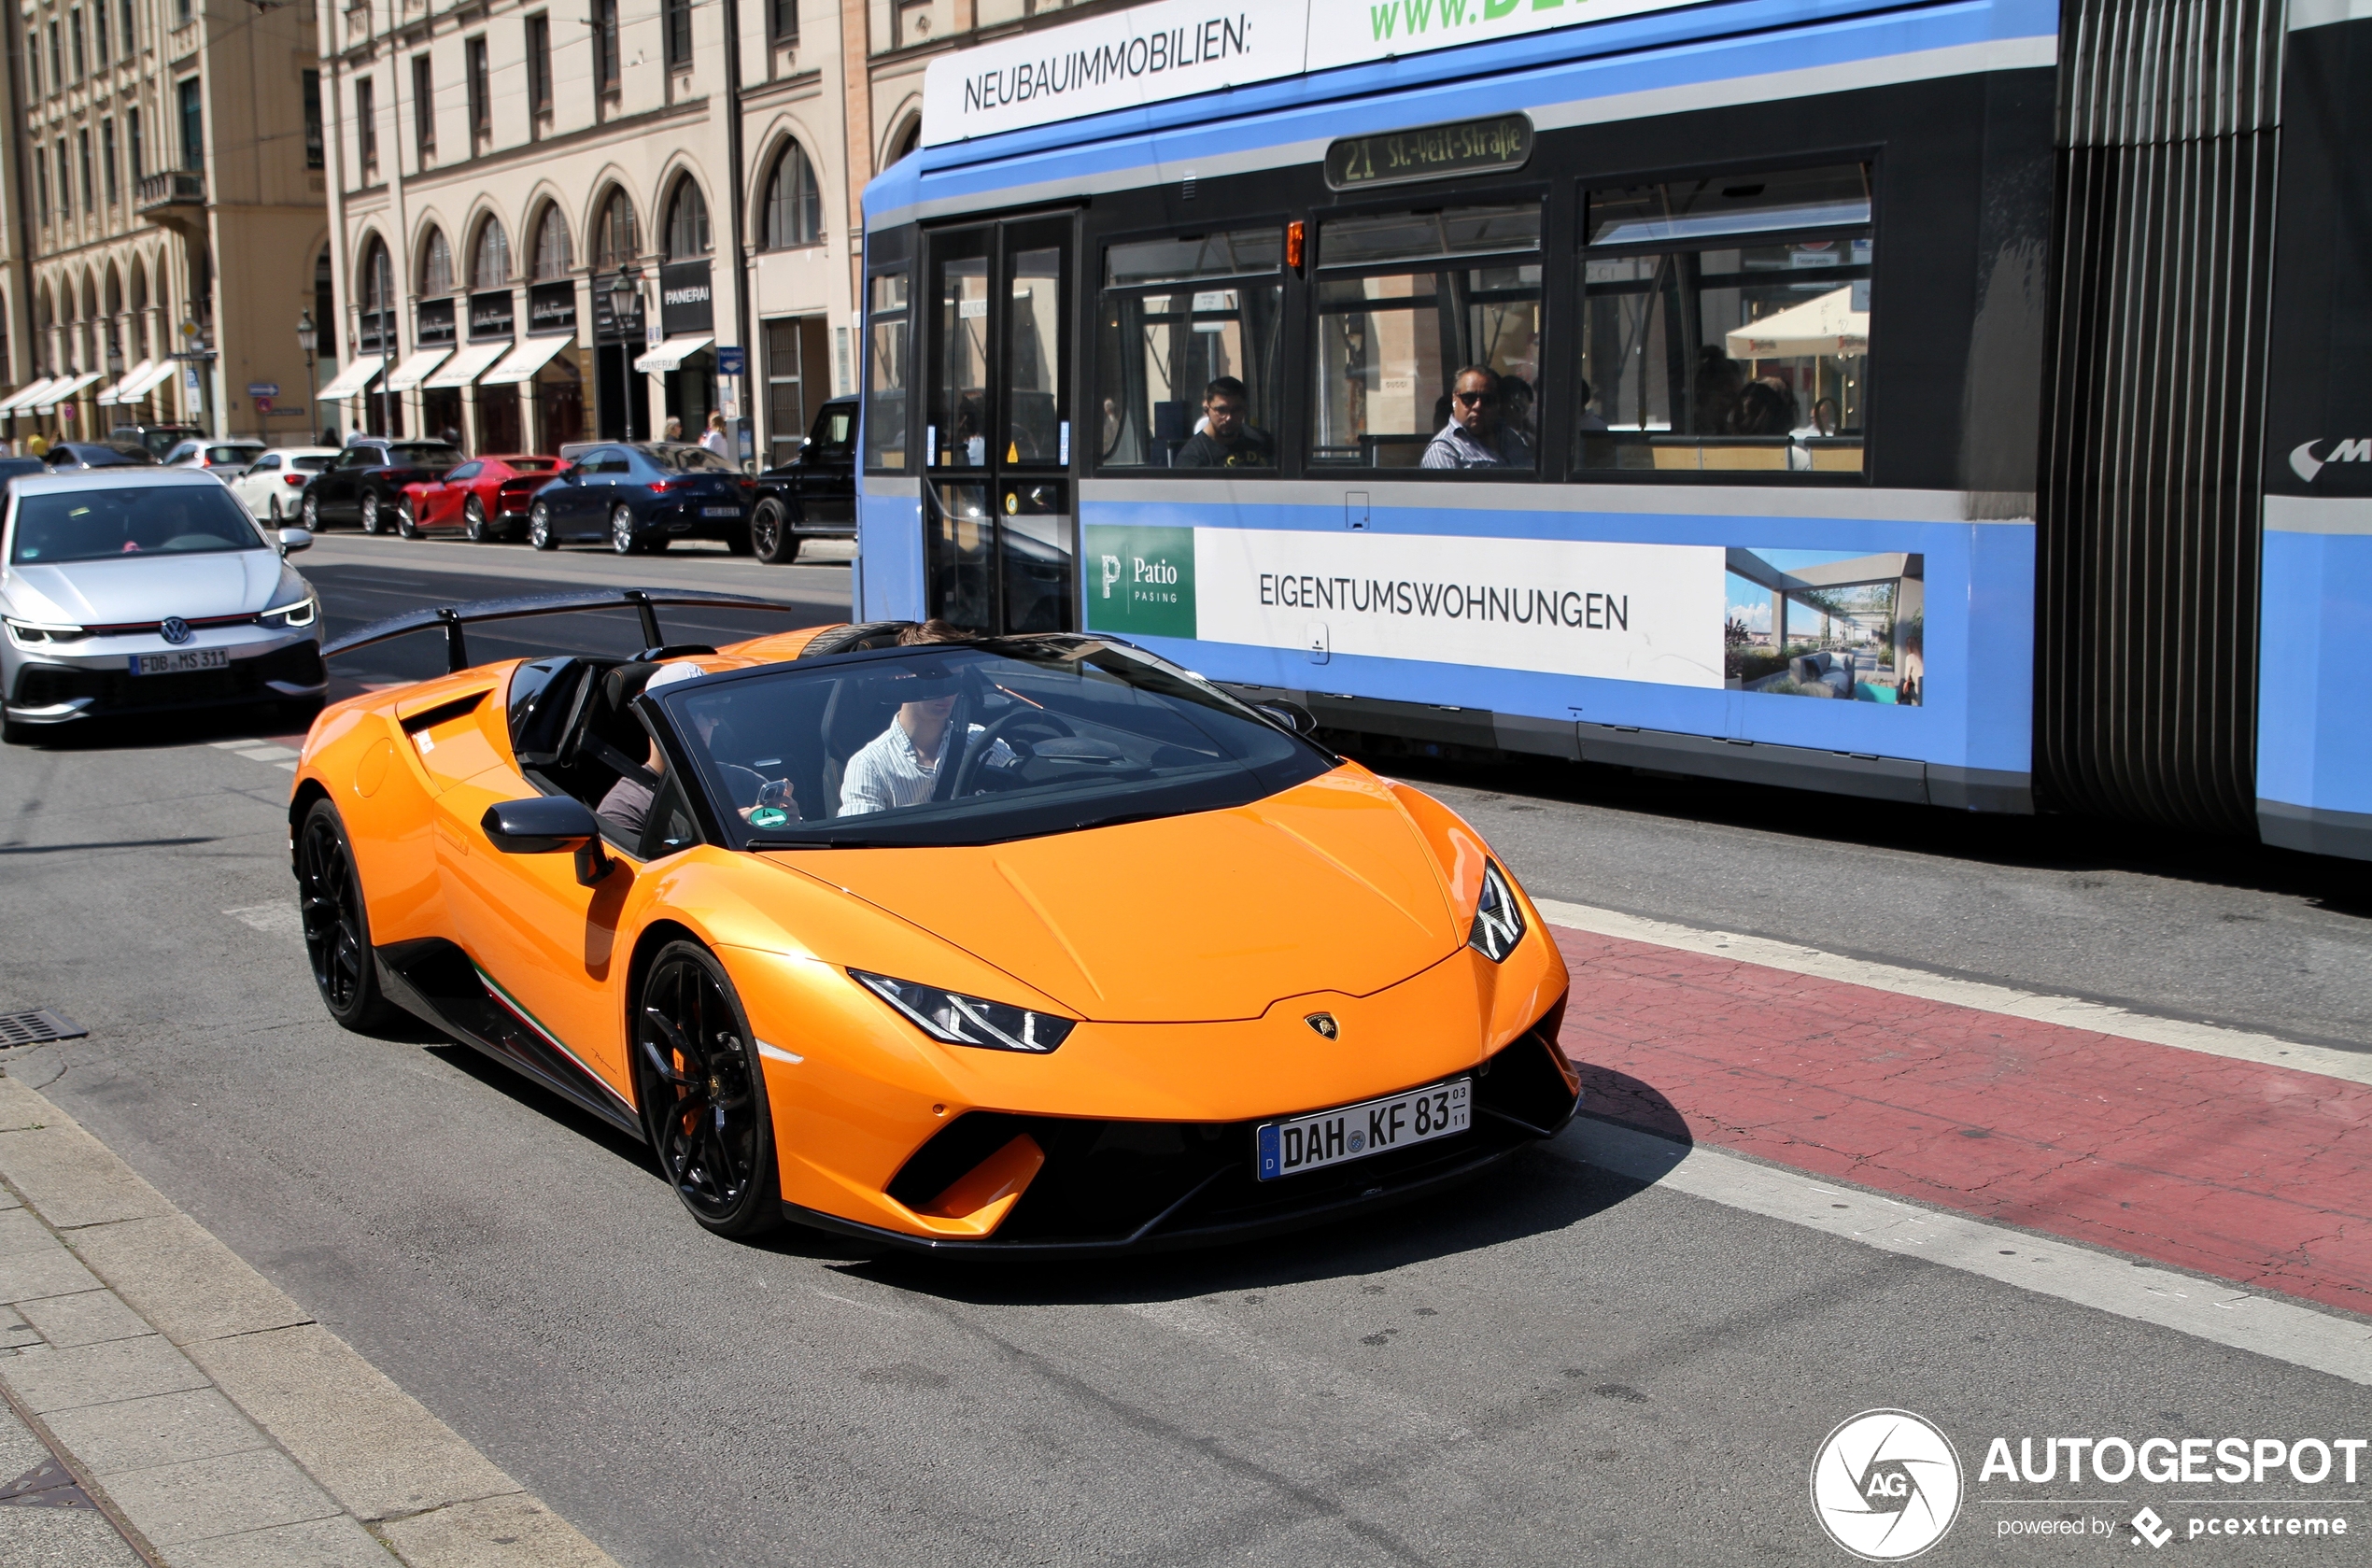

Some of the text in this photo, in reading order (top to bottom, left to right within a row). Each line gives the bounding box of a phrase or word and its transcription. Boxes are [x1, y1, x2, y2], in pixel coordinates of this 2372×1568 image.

[964, 13, 1252, 114] NEUBAUIMMOBILIEN:
[1345, 121, 1522, 180] 21 St.-Veit-Straße
[664, 286, 710, 305] PANERAI
[640, 359, 677, 371] PANERAI
[1133, 557, 1178, 586] Patio
[1134, 590, 1178, 603] PASING
[1260, 573, 1629, 632] EIGENTUMSWOHNUNGEN
[140, 650, 227, 672] FDB MS 311
[1452, 1087, 1466, 1100] 03
[1454, 1112, 1466, 1126] 11
[1283, 1091, 1449, 1168] DAH KF 83
[1265, 1158, 1274, 1170] D
